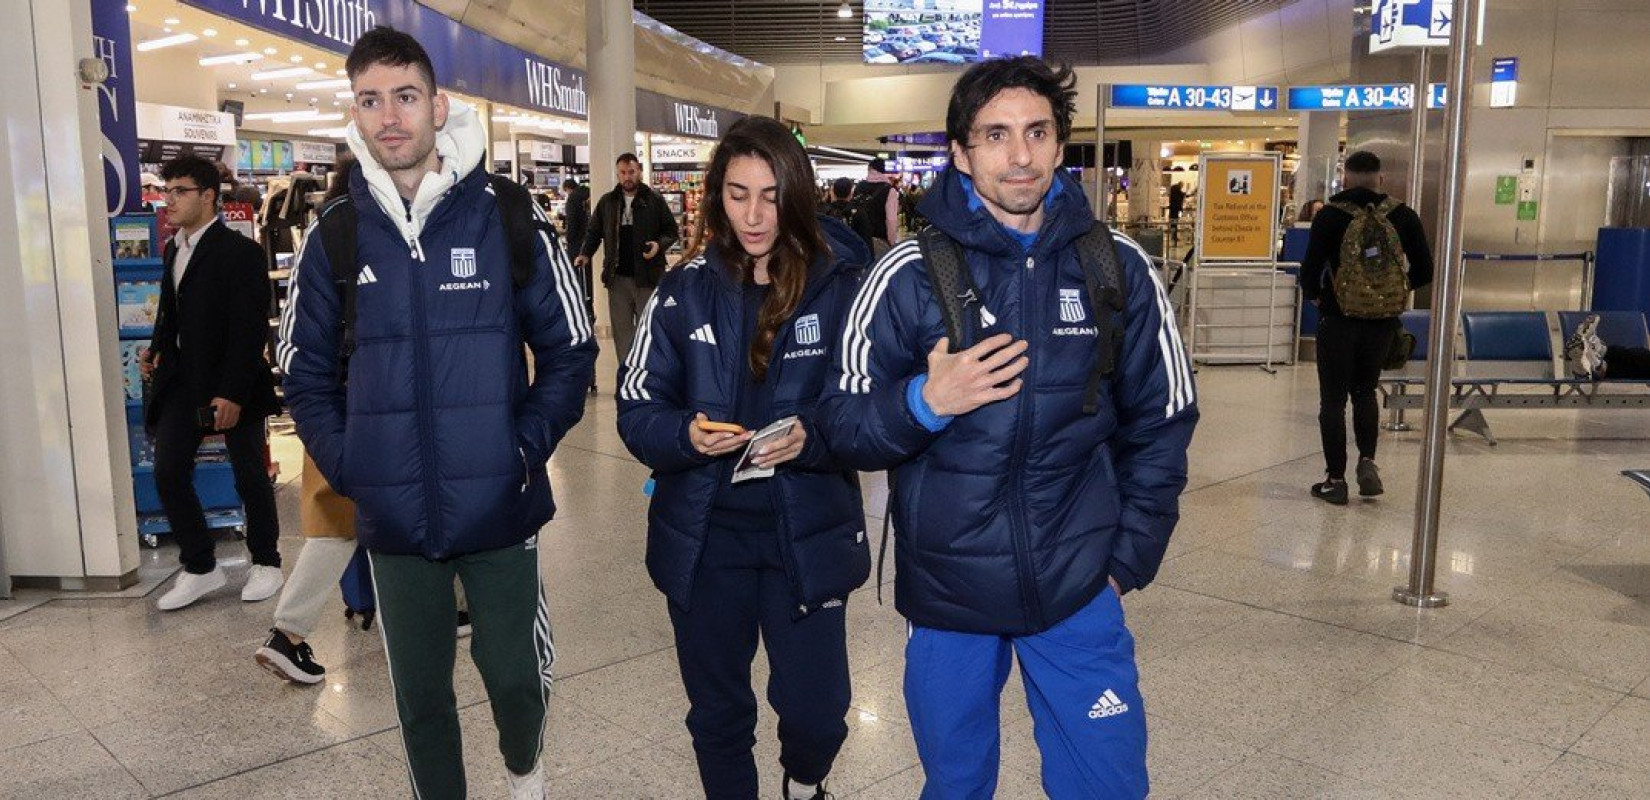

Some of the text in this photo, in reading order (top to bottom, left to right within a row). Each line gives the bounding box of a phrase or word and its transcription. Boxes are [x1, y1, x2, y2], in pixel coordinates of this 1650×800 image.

[242, 0, 376, 46] mith
[525, 58, 586, 115] WHSmith
[1168, 87, 1231, 107] A 30-43
[1345, 87, 1410, 107] A 30-43
[674, 102, 718, 138] WHSmith
[183, 127, 218, 141] SOUVENIRS
[656, 148, 697, 158] SNACKS
[439, 282, 481, 291] AEGEAN
[1052, 327, 1093, 336] AEGEAN
[783, 348, 824, 360] AEGEAN
[1088, 702, 1129, 719] adidas
